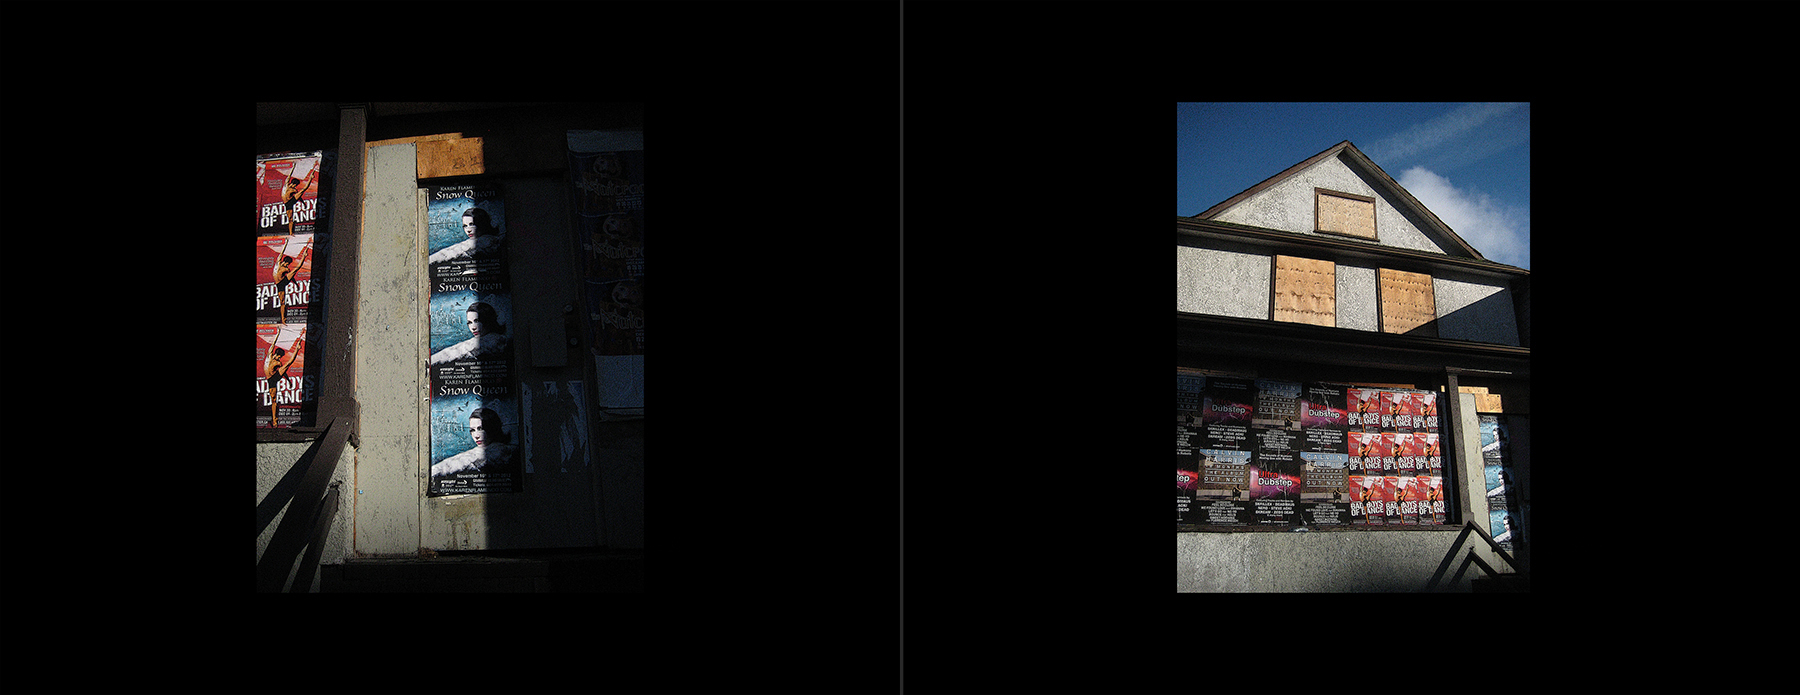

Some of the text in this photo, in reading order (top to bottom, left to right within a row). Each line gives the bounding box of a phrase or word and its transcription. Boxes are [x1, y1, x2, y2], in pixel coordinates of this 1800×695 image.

[436, 190, 496, 200] Snow Queen
[262, 203, 287, 217] BAD
[261, 215, 277, 228] OF
[438, 281, 503, 293] Snow Queen
[439, 384, 508, 397] Snow Queen
[1260, 382, 1296, 390] CALVIN
[1211, 404, 1246, 415] Dubstep
[1308, 409, 1340, 419] Dubstep
[1258, 470, 1278, 478] Ultra
[1258, 477, 1293, 488] Dubstep
